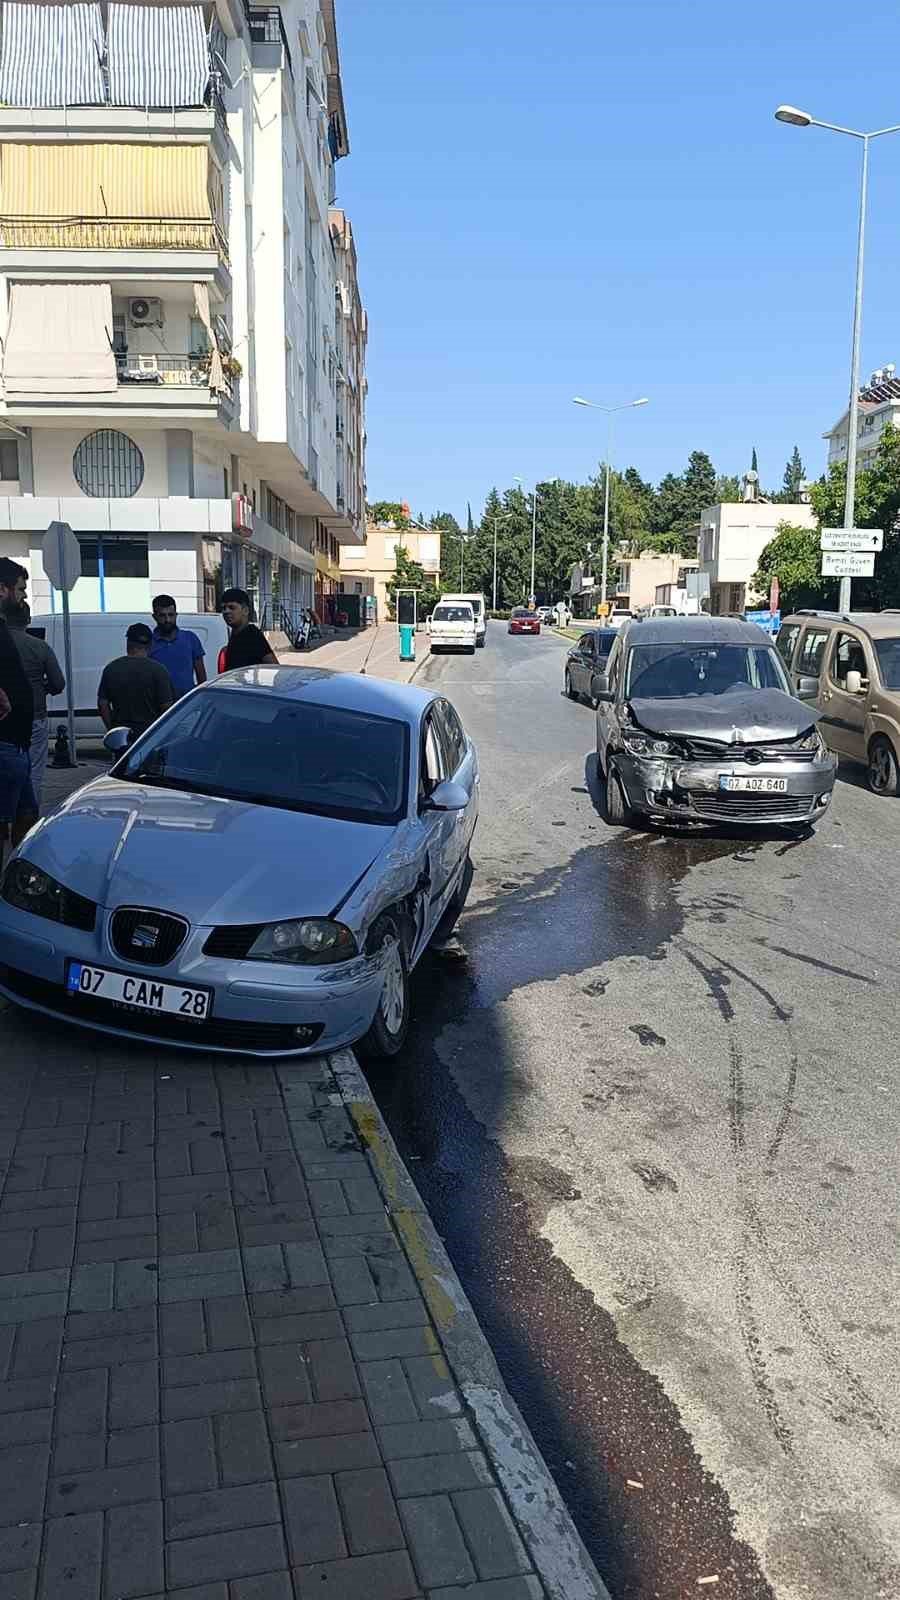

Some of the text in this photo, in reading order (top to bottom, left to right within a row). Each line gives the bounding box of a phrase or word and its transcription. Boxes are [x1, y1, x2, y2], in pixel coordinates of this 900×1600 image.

[766, 779, 785, 790] 640
[80, 968, 105, 993] 07
[123, 978, 164, 1008] CAM
[179, 990, 206, 1015] 28
